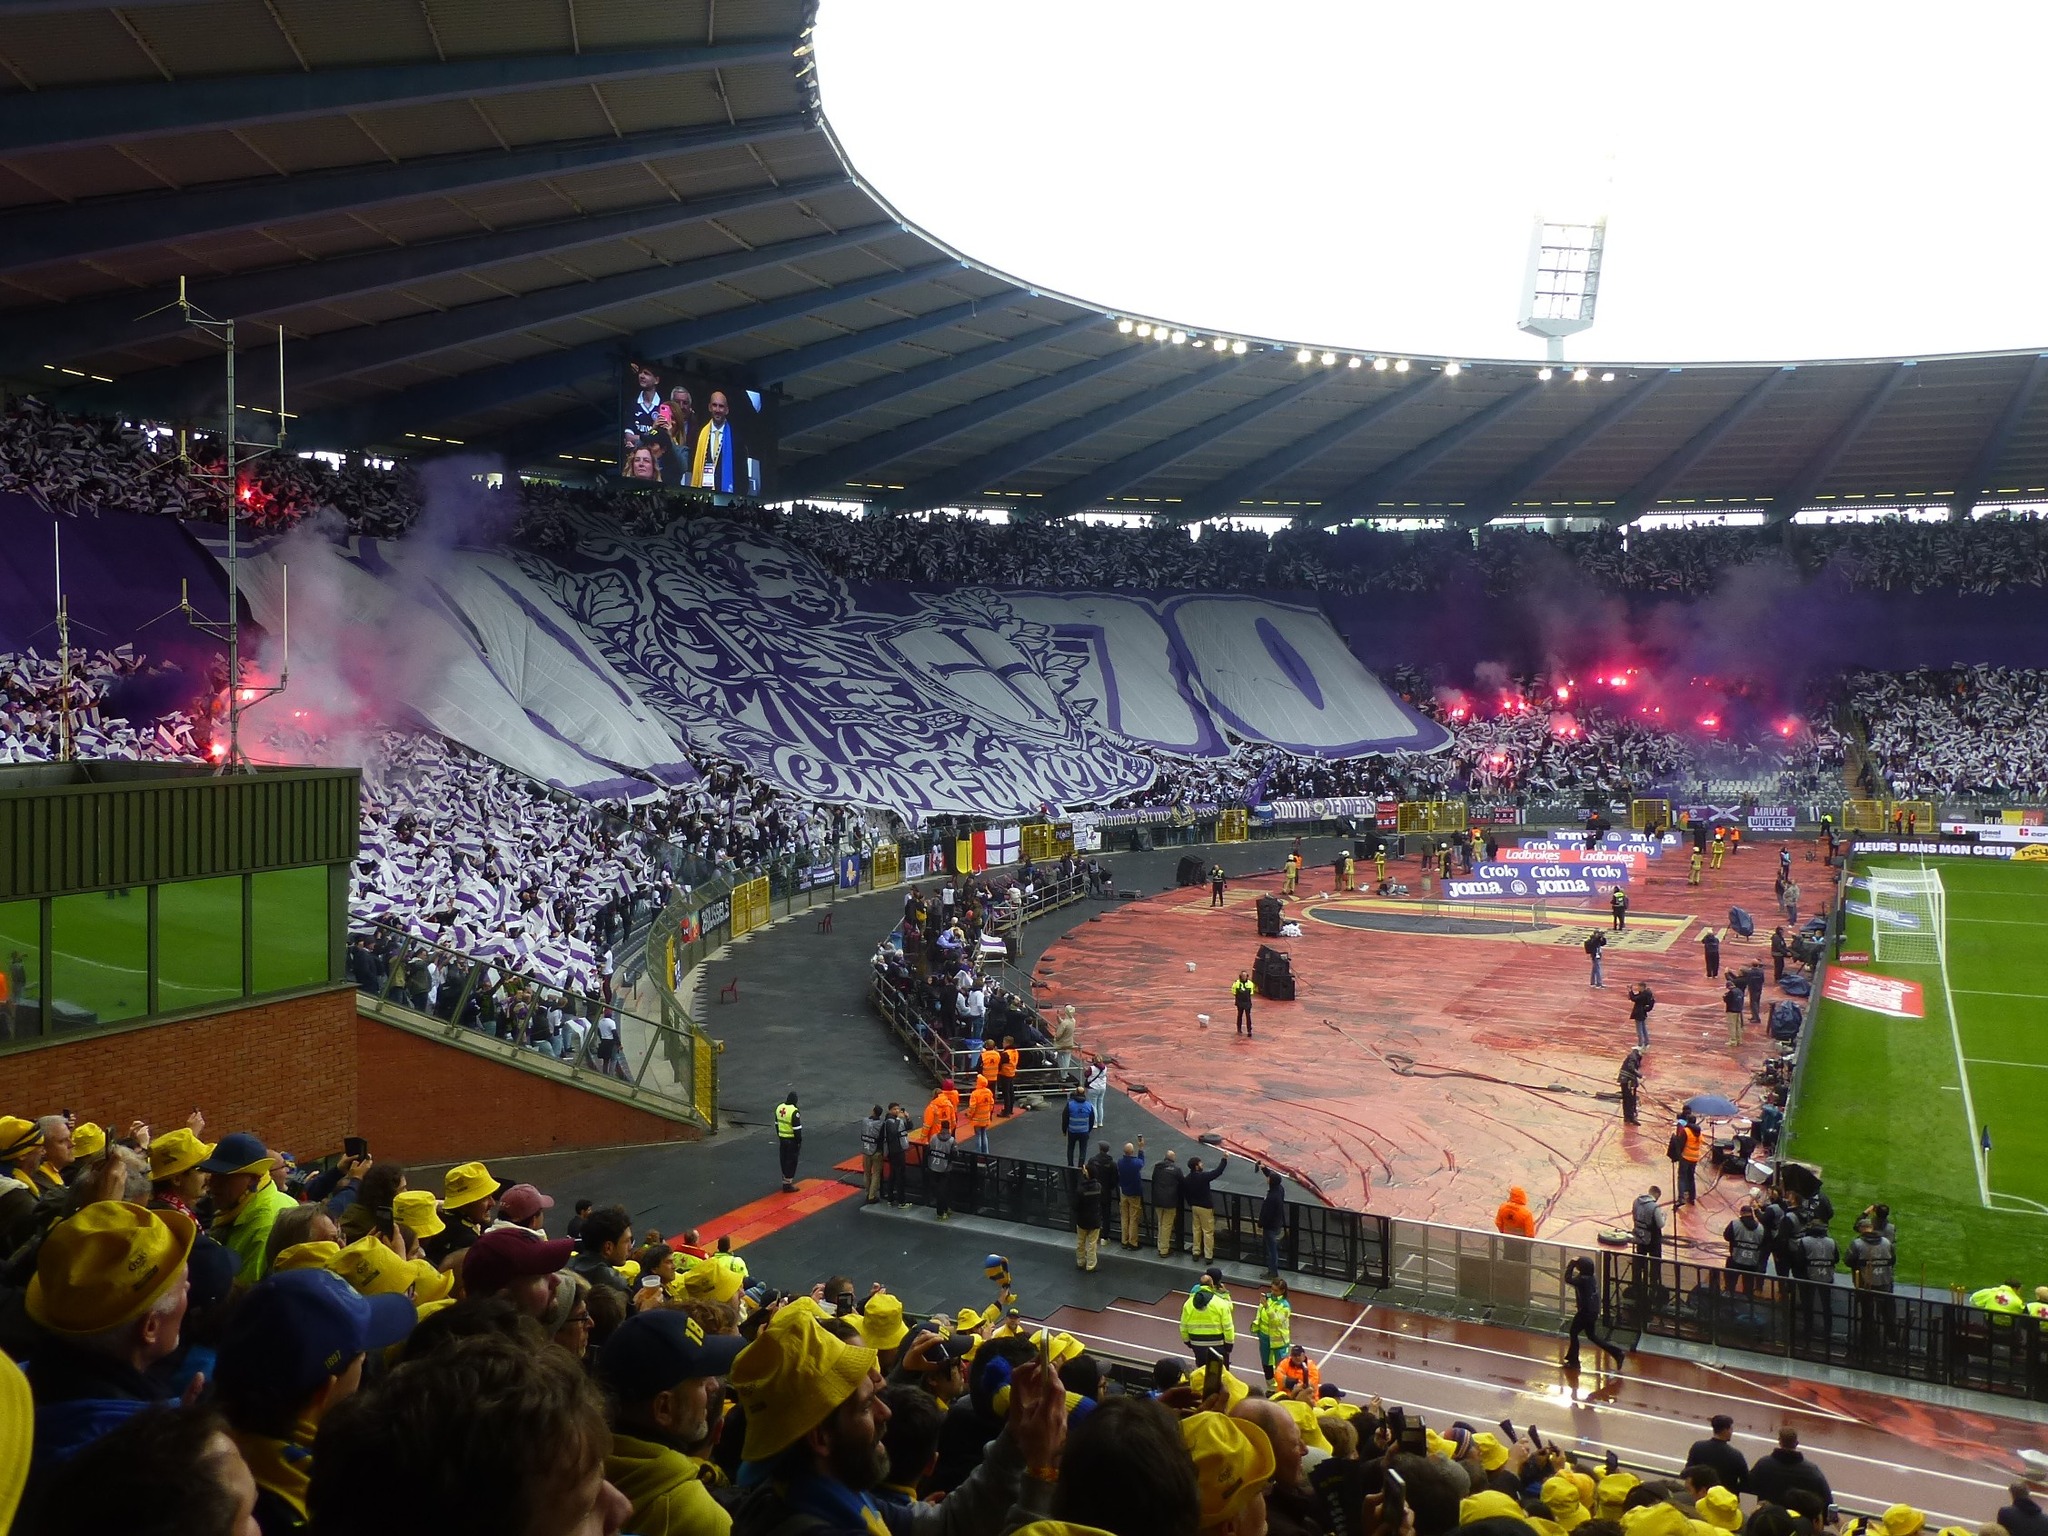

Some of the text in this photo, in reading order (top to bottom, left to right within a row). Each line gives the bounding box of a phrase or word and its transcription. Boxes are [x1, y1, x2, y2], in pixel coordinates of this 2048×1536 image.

[1139, 809, 1171, 824] Army
[1196, 805, 1219, 818] 2003
[1271, 800, 1311, 819] SOUTH
[1754, 807, 1788, 816] MAUVE
[1751, 817, 1793, 826] WUITENS
[1618, 842, 1655, 856] Croky
[1899, 843, 1937, 854] DANS
[1939, 844, 1971, 855] MON
[1505, 849, 1635, 863] Ladbrokes Ladbrokes
[1479, 865, 1622, 879] Croky Croky Croky
[932, 1157, 941, 1165] 73
[1741, 1250, 1754, 1259] 63
[1817, 1267, 1828, 1276] 14
